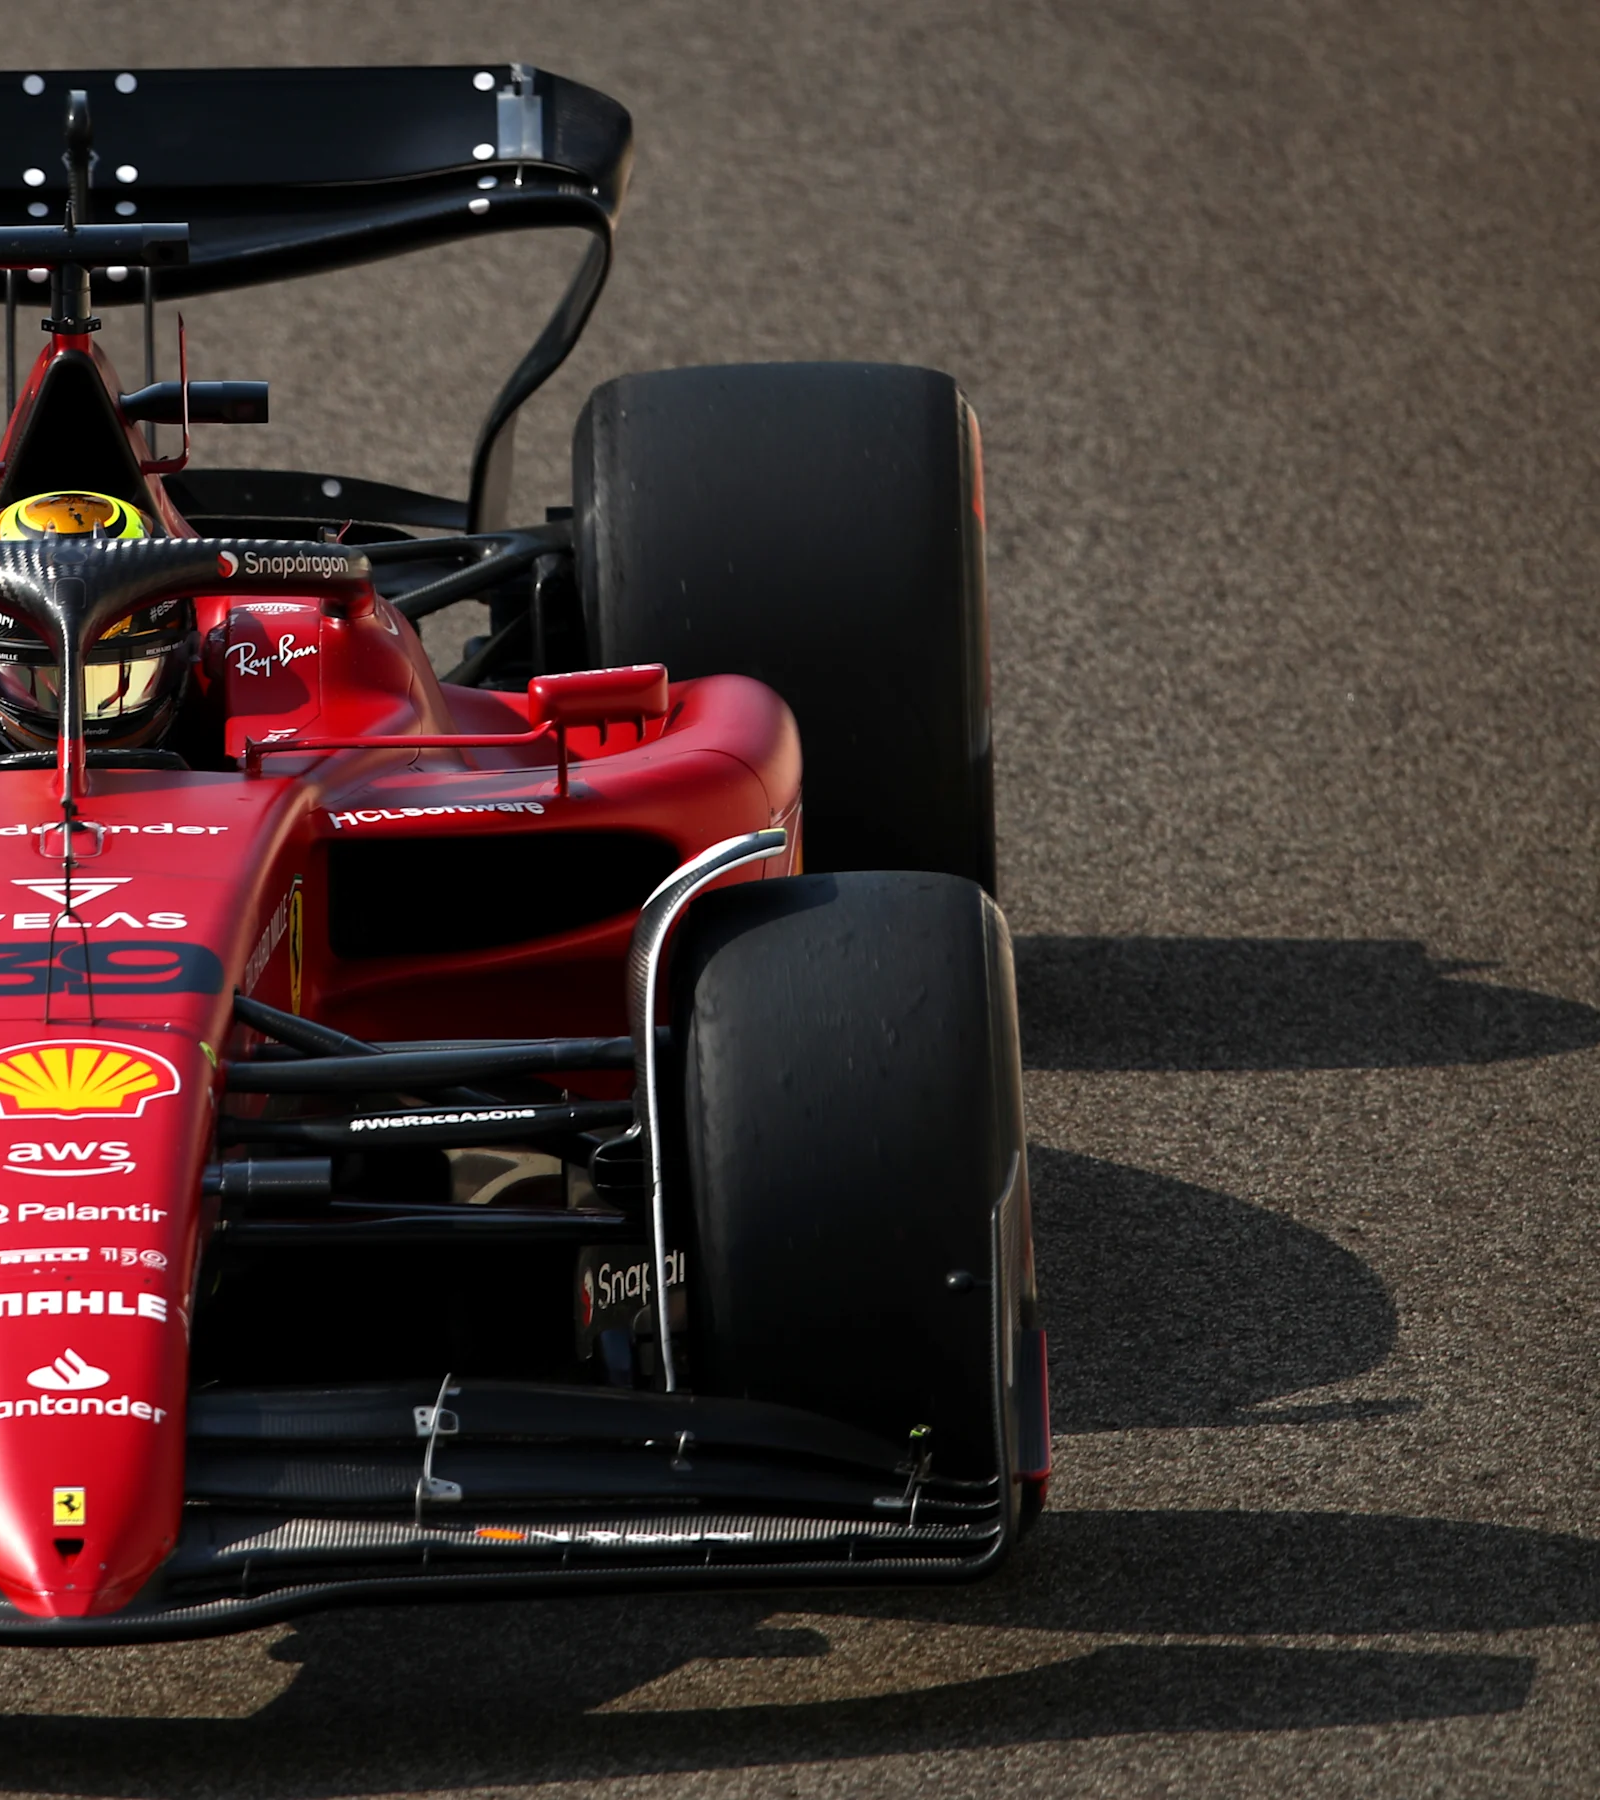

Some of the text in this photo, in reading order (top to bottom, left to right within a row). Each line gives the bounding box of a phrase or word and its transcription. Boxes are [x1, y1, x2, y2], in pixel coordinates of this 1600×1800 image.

[244, 550, 349, 579] Snapdragon
[225, 634, 319, 677] Ray-Ban
[350, 1108, 536, 1132] #WeRaceAsOne
[7, 1141, 132, 1163] aws
[18, 1202, 168, 1223] Palantir
